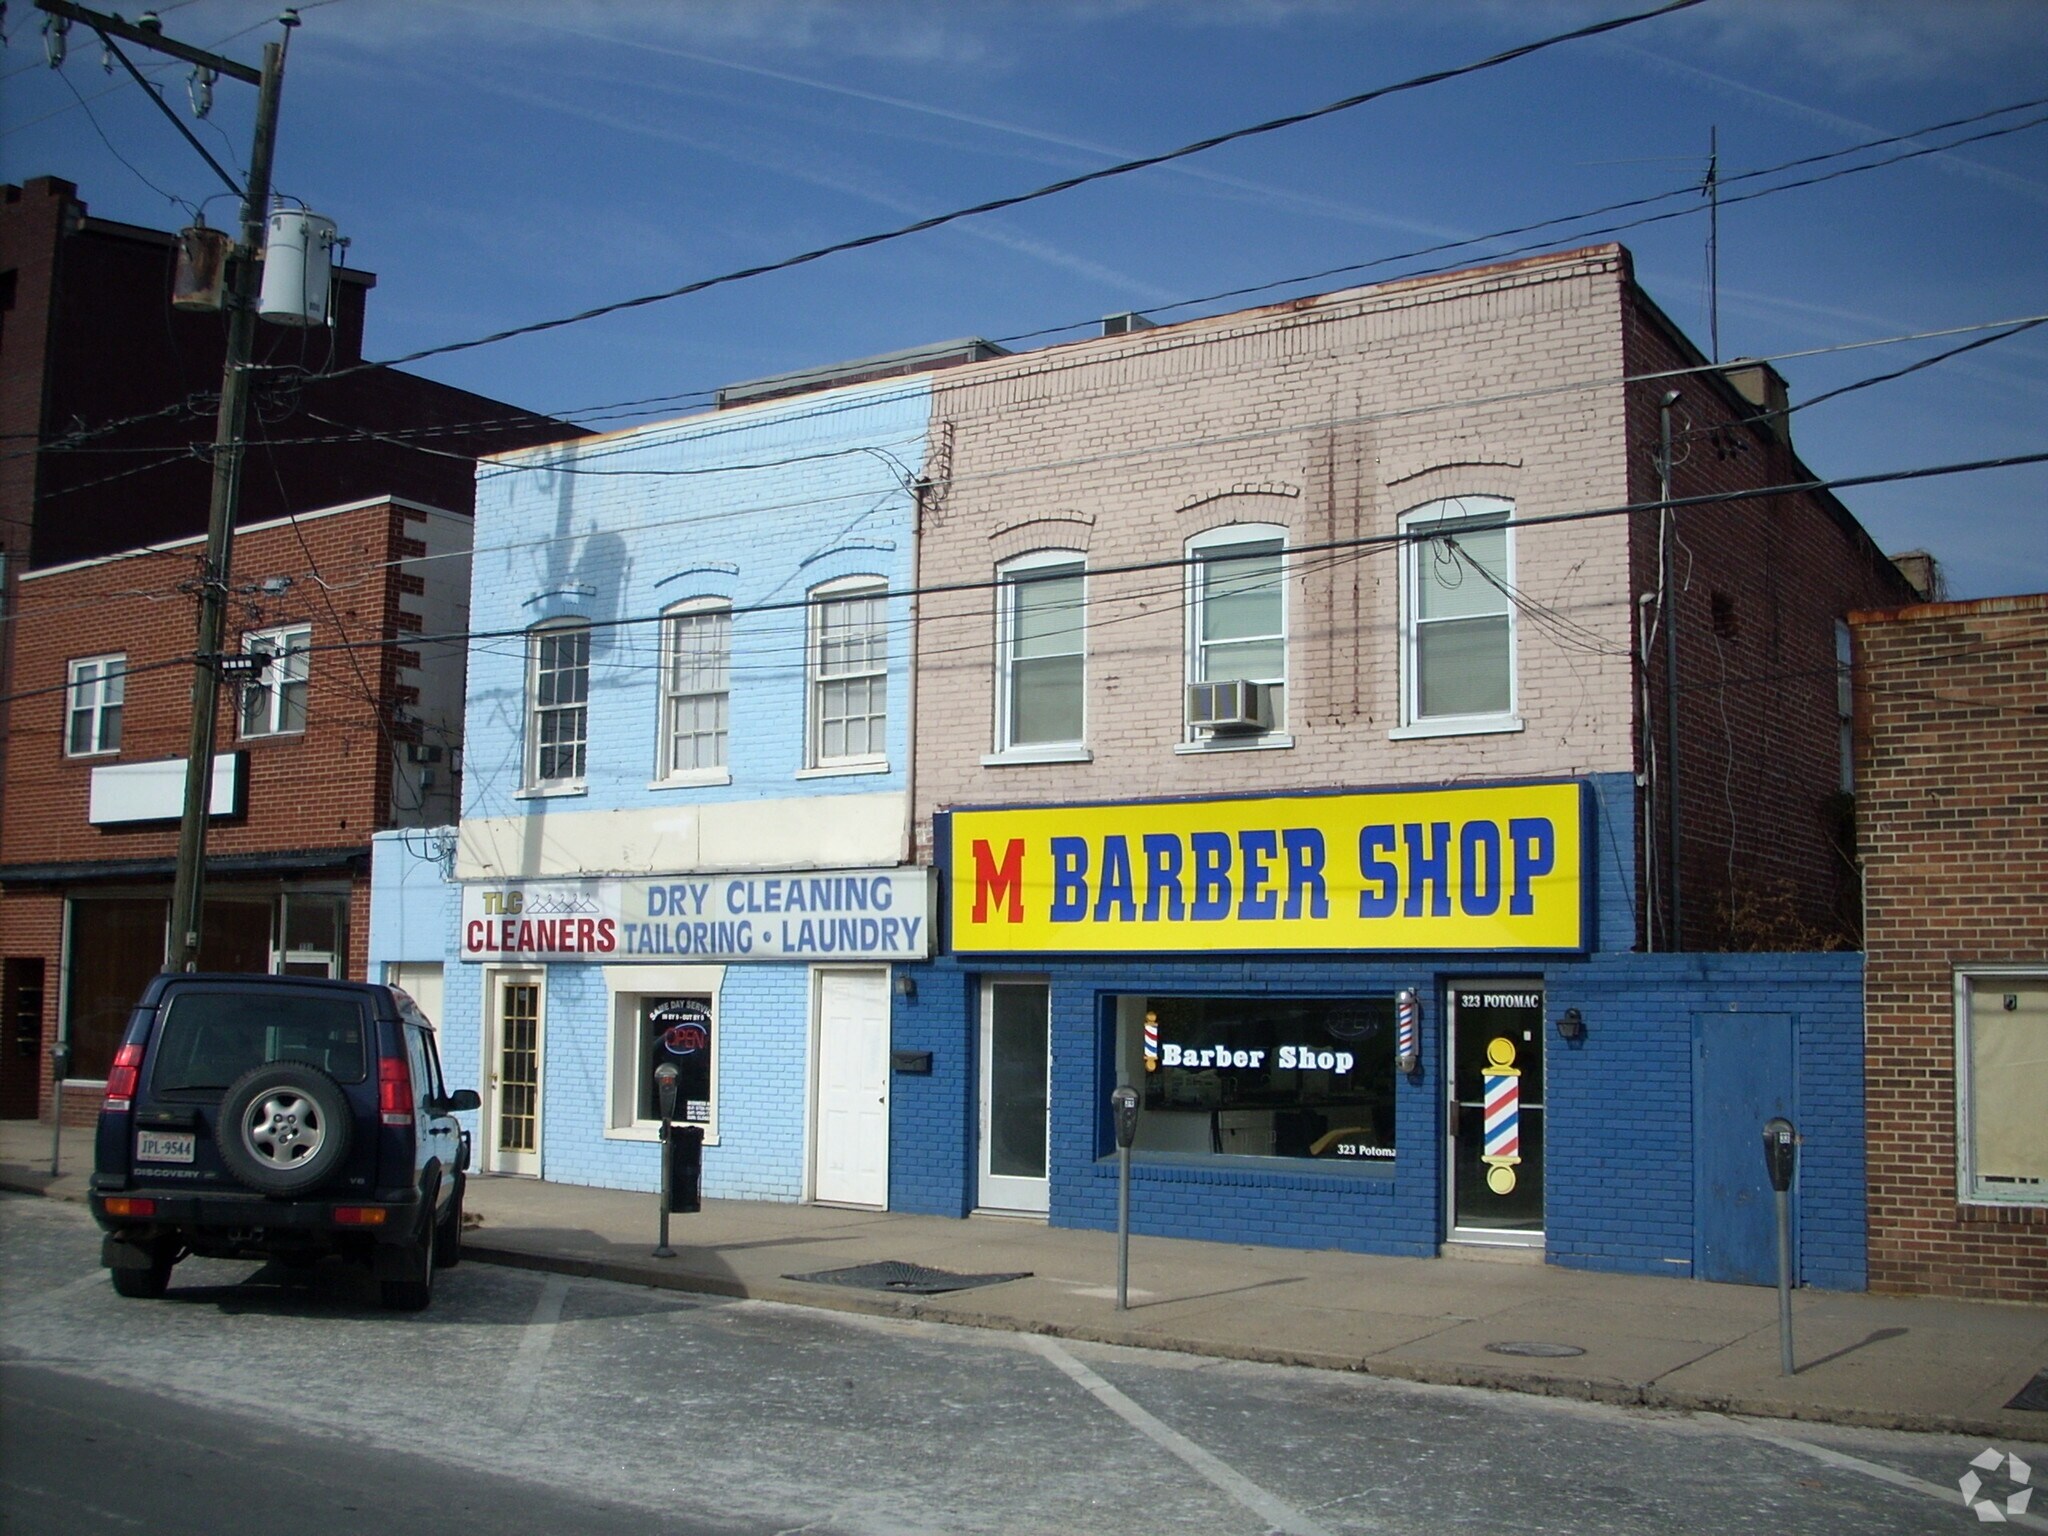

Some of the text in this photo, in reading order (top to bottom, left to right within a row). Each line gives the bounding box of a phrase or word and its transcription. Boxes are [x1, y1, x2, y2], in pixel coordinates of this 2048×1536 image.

[971, 817, 1555, 923] M BARBER SHOP
[482, 890, 524, 915] TLC
[647, 876, 892, 917] DRY CLEANING
[467, 918, 616, 953] CLEANERS
[624, 916, 922, 955] TAILORING LAUNDRY
[649, 1002, 670, 1021] SAME
[670, 1000, 686, 1009] DAY
[1461, 994, 1539, 1008] 323 POTOMAC
[1326, 1009, 1379, 1031] OPEN
[665, 1027, 705, 1049] OPEN
[1161, 1043, 1354, 1074] Barber Shop
[1337, 1143, 1356, 1155] 323
[133, 1167, 200, 1178] DISCOVERY
